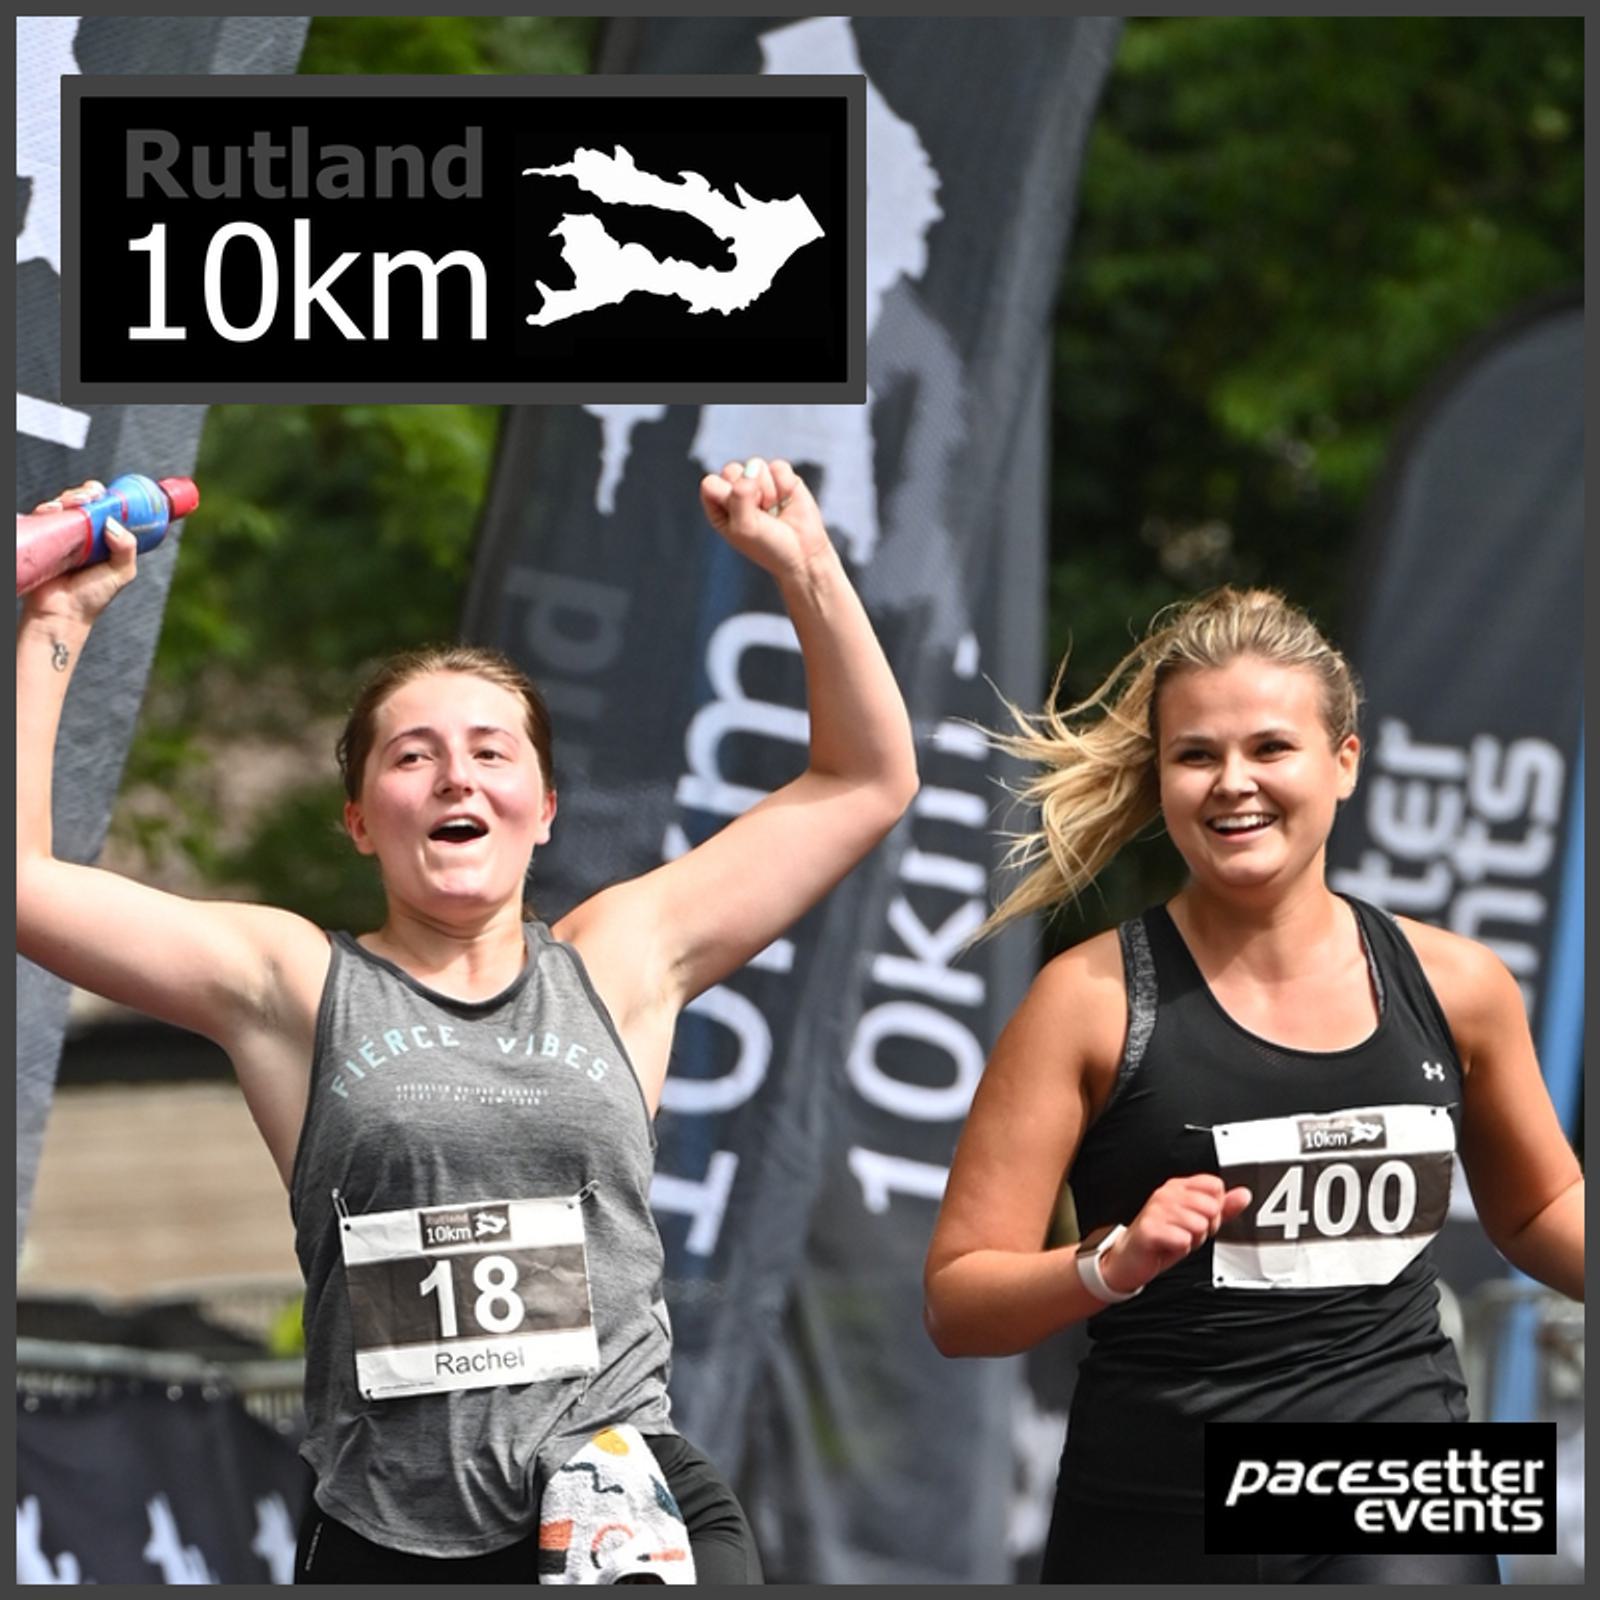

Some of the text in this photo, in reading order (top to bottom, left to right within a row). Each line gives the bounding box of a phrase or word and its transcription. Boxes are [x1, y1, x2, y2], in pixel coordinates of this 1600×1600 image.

[330, 1025, 610, 1099] FIERCE VIBES
[1304, 1129, 1348, 1149] 10km
[1256, 1160, 1417, 1240] 400
[426, 1225, 472, 1244] 10km
[419, 1255, 525, 1338] 18
[435, 1347, 525, 1376] Rachel
